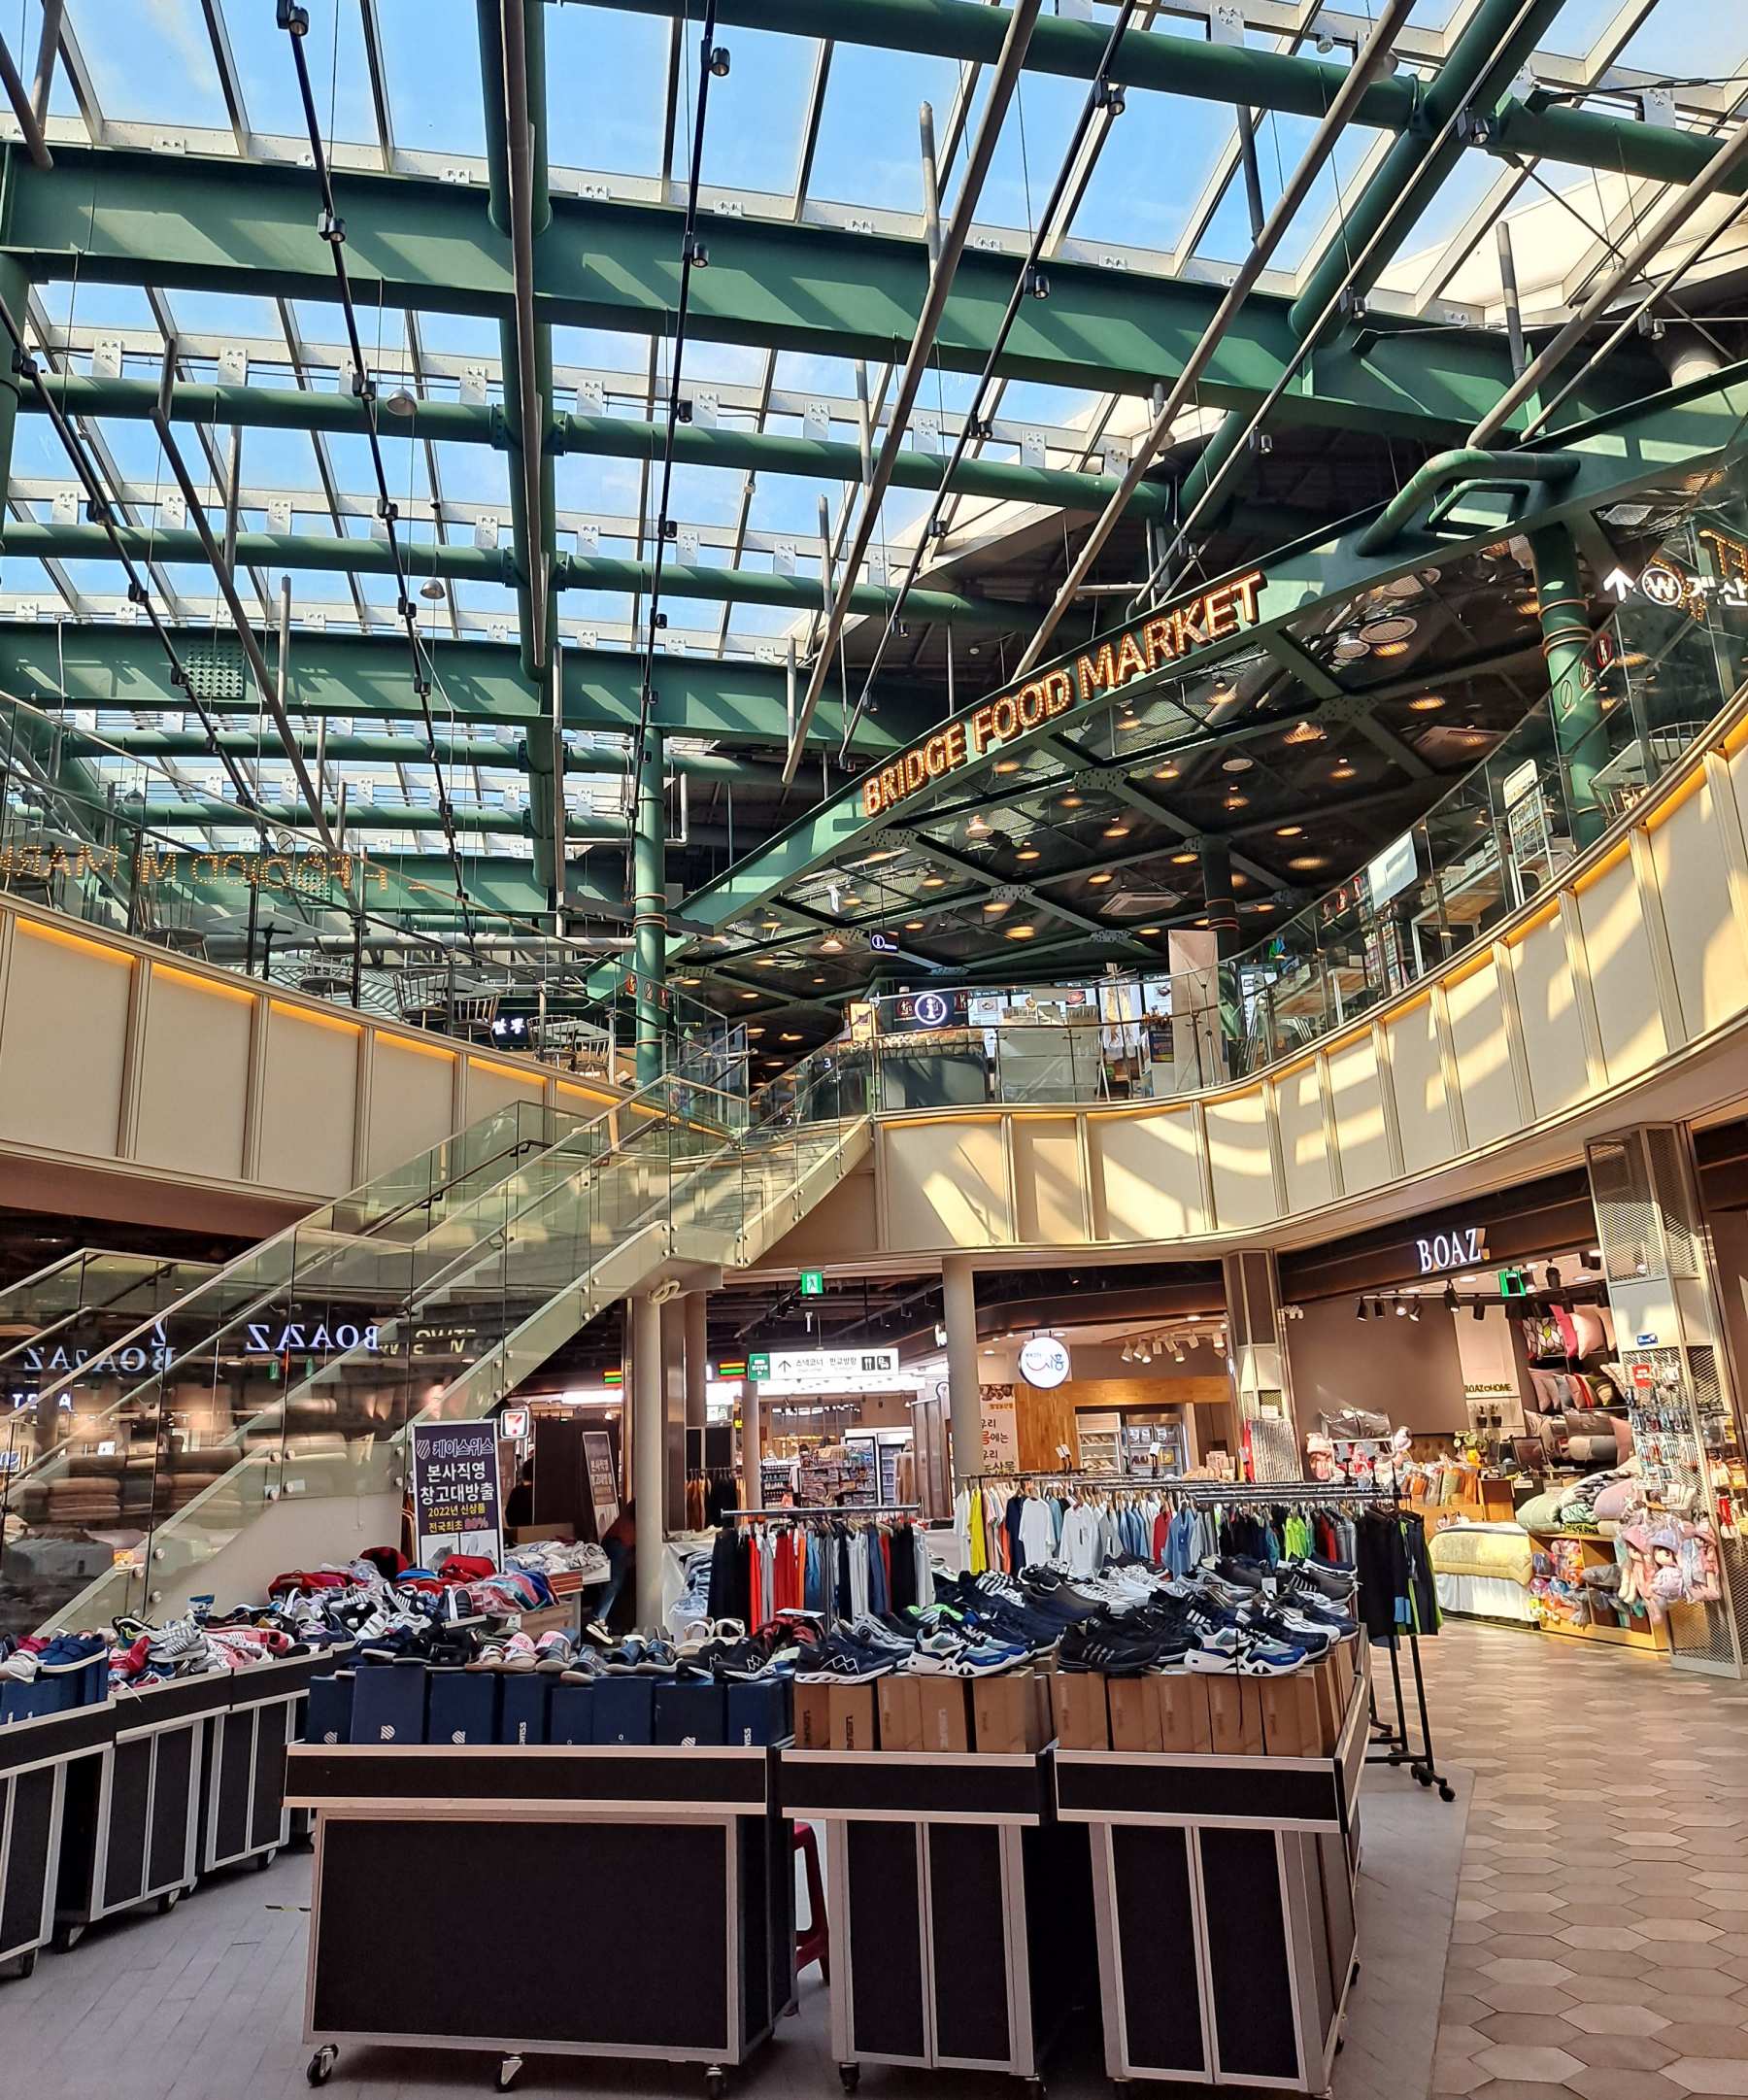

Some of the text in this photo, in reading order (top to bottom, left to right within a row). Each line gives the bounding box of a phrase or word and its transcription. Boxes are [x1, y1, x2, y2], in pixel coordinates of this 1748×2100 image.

[862, 571, 1268, 818] BRIDGE FOOD MARKET
[1416, 1227, 1483, 1273] BOAZ
[432, 1438, 494, 1459] 케이스위스
[427, 1461, 486, 1482] 본사직영
[420, 1482, 494, 1506] 창고대방출
[428, 1505, 458, 1517] 2022년
